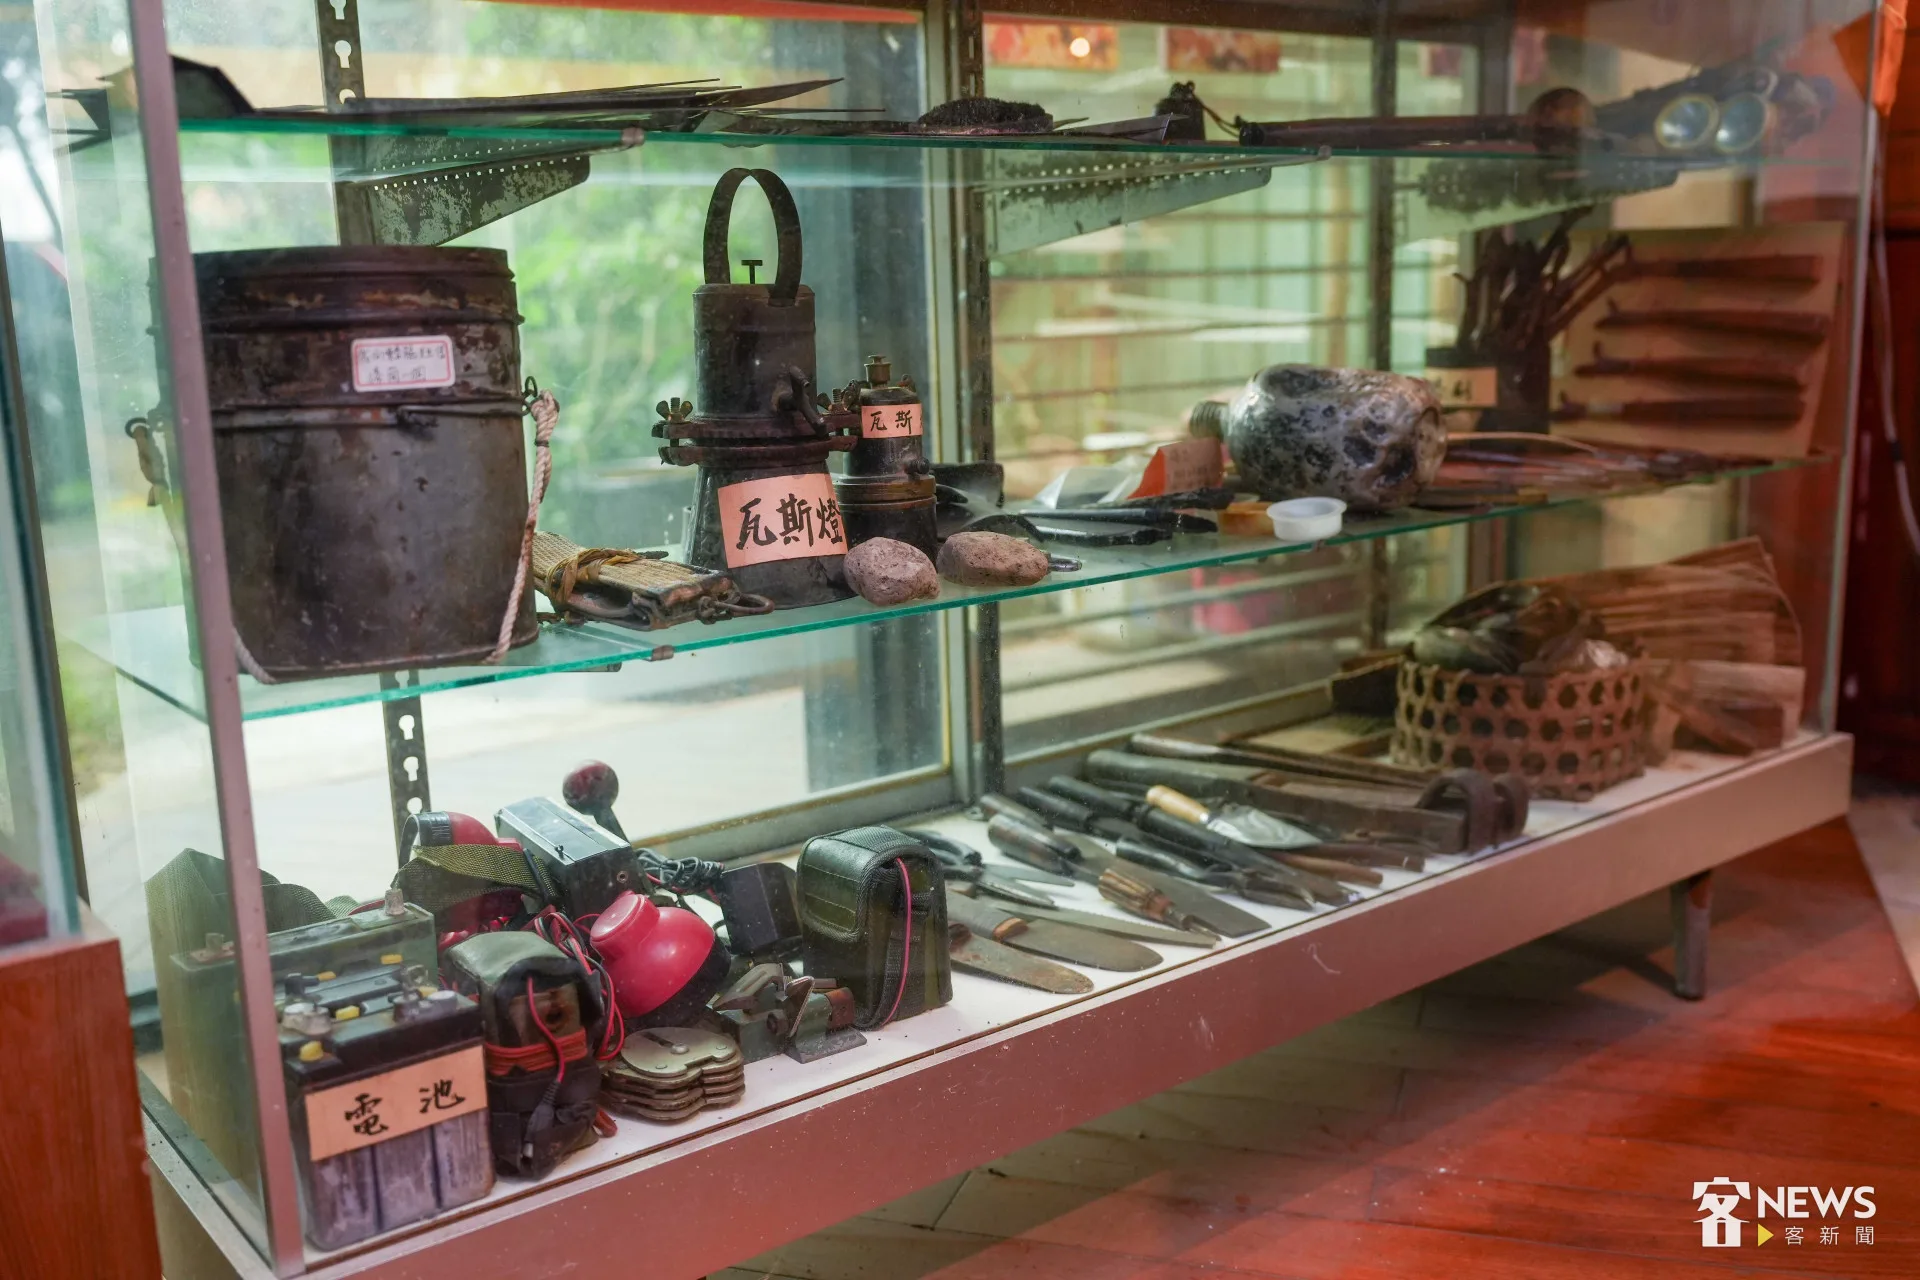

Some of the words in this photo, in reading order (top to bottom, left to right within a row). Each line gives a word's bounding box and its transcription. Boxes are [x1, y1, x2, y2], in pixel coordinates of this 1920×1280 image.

[870, 409, 923, 435] 瓦斯
[735, 493, 844, 551] 瓦斯燈
[344, 1079, 466, 1136] 電池
